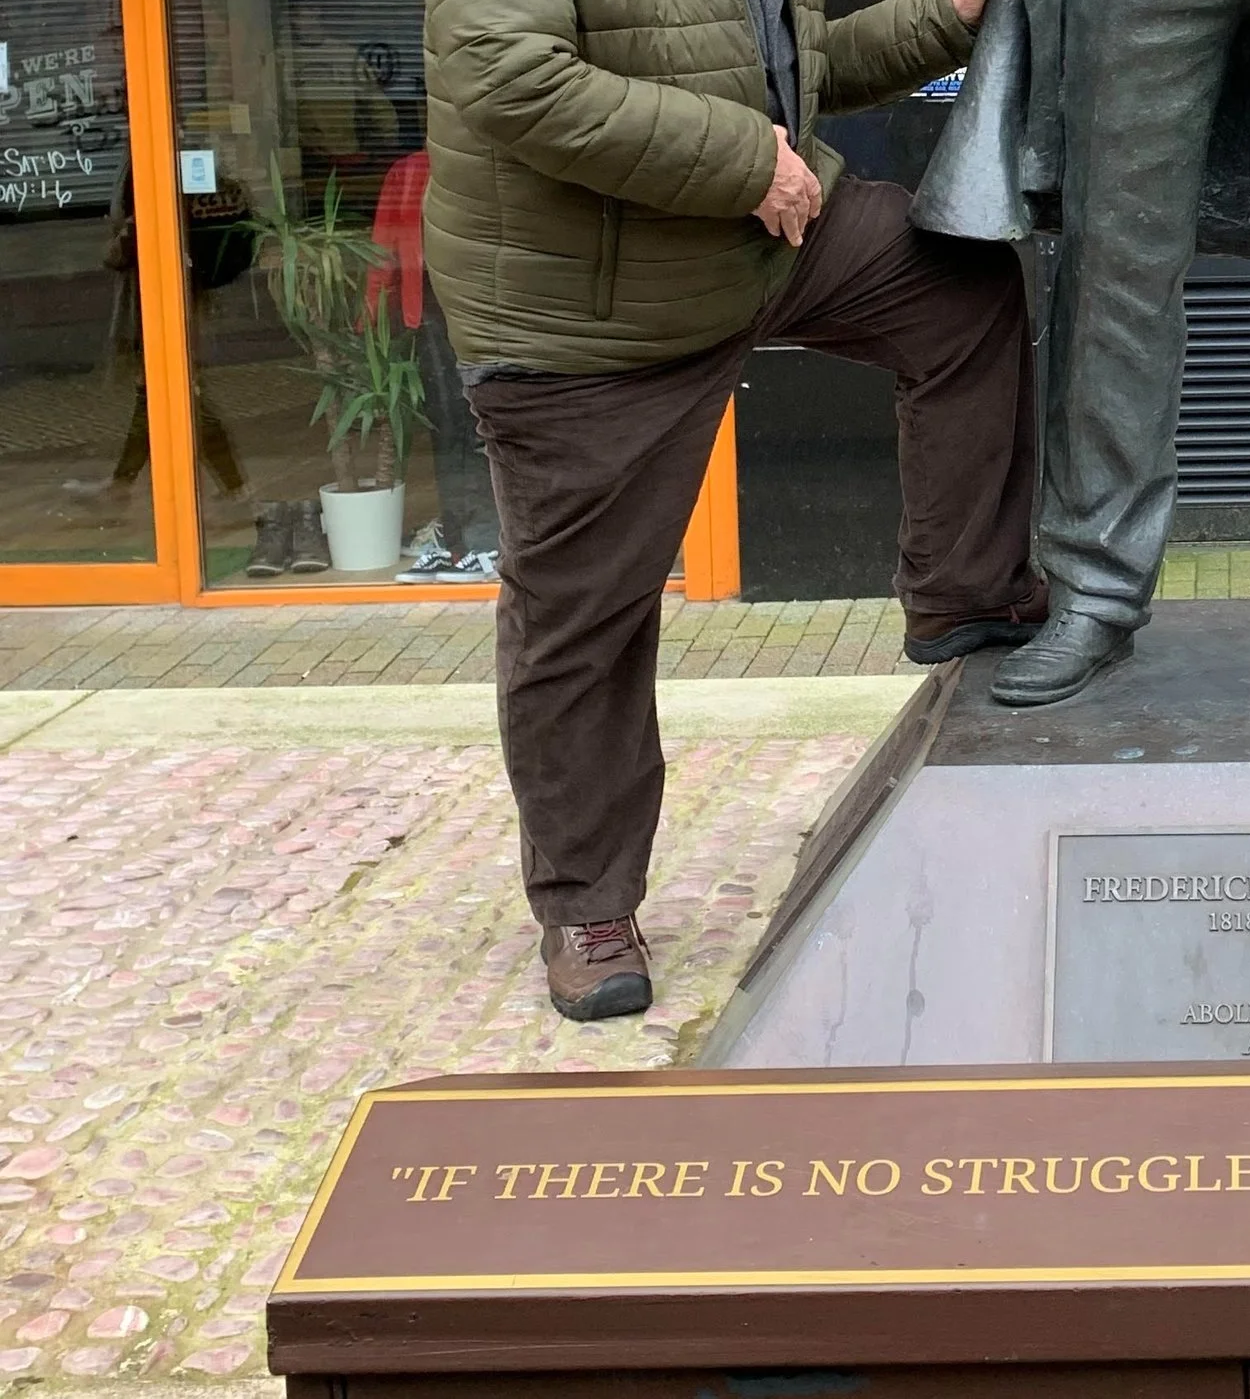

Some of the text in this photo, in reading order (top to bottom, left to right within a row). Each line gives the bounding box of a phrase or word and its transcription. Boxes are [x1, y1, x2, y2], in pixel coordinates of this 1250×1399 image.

[21, 46, 96, 75] WE'RE
[391, 1164, 478, 1202] "IF
[494, 1161, 710, 1199] THERE
[724, 1160, 786, 1197] IS
[802, 1159, 901, 1196] NO
